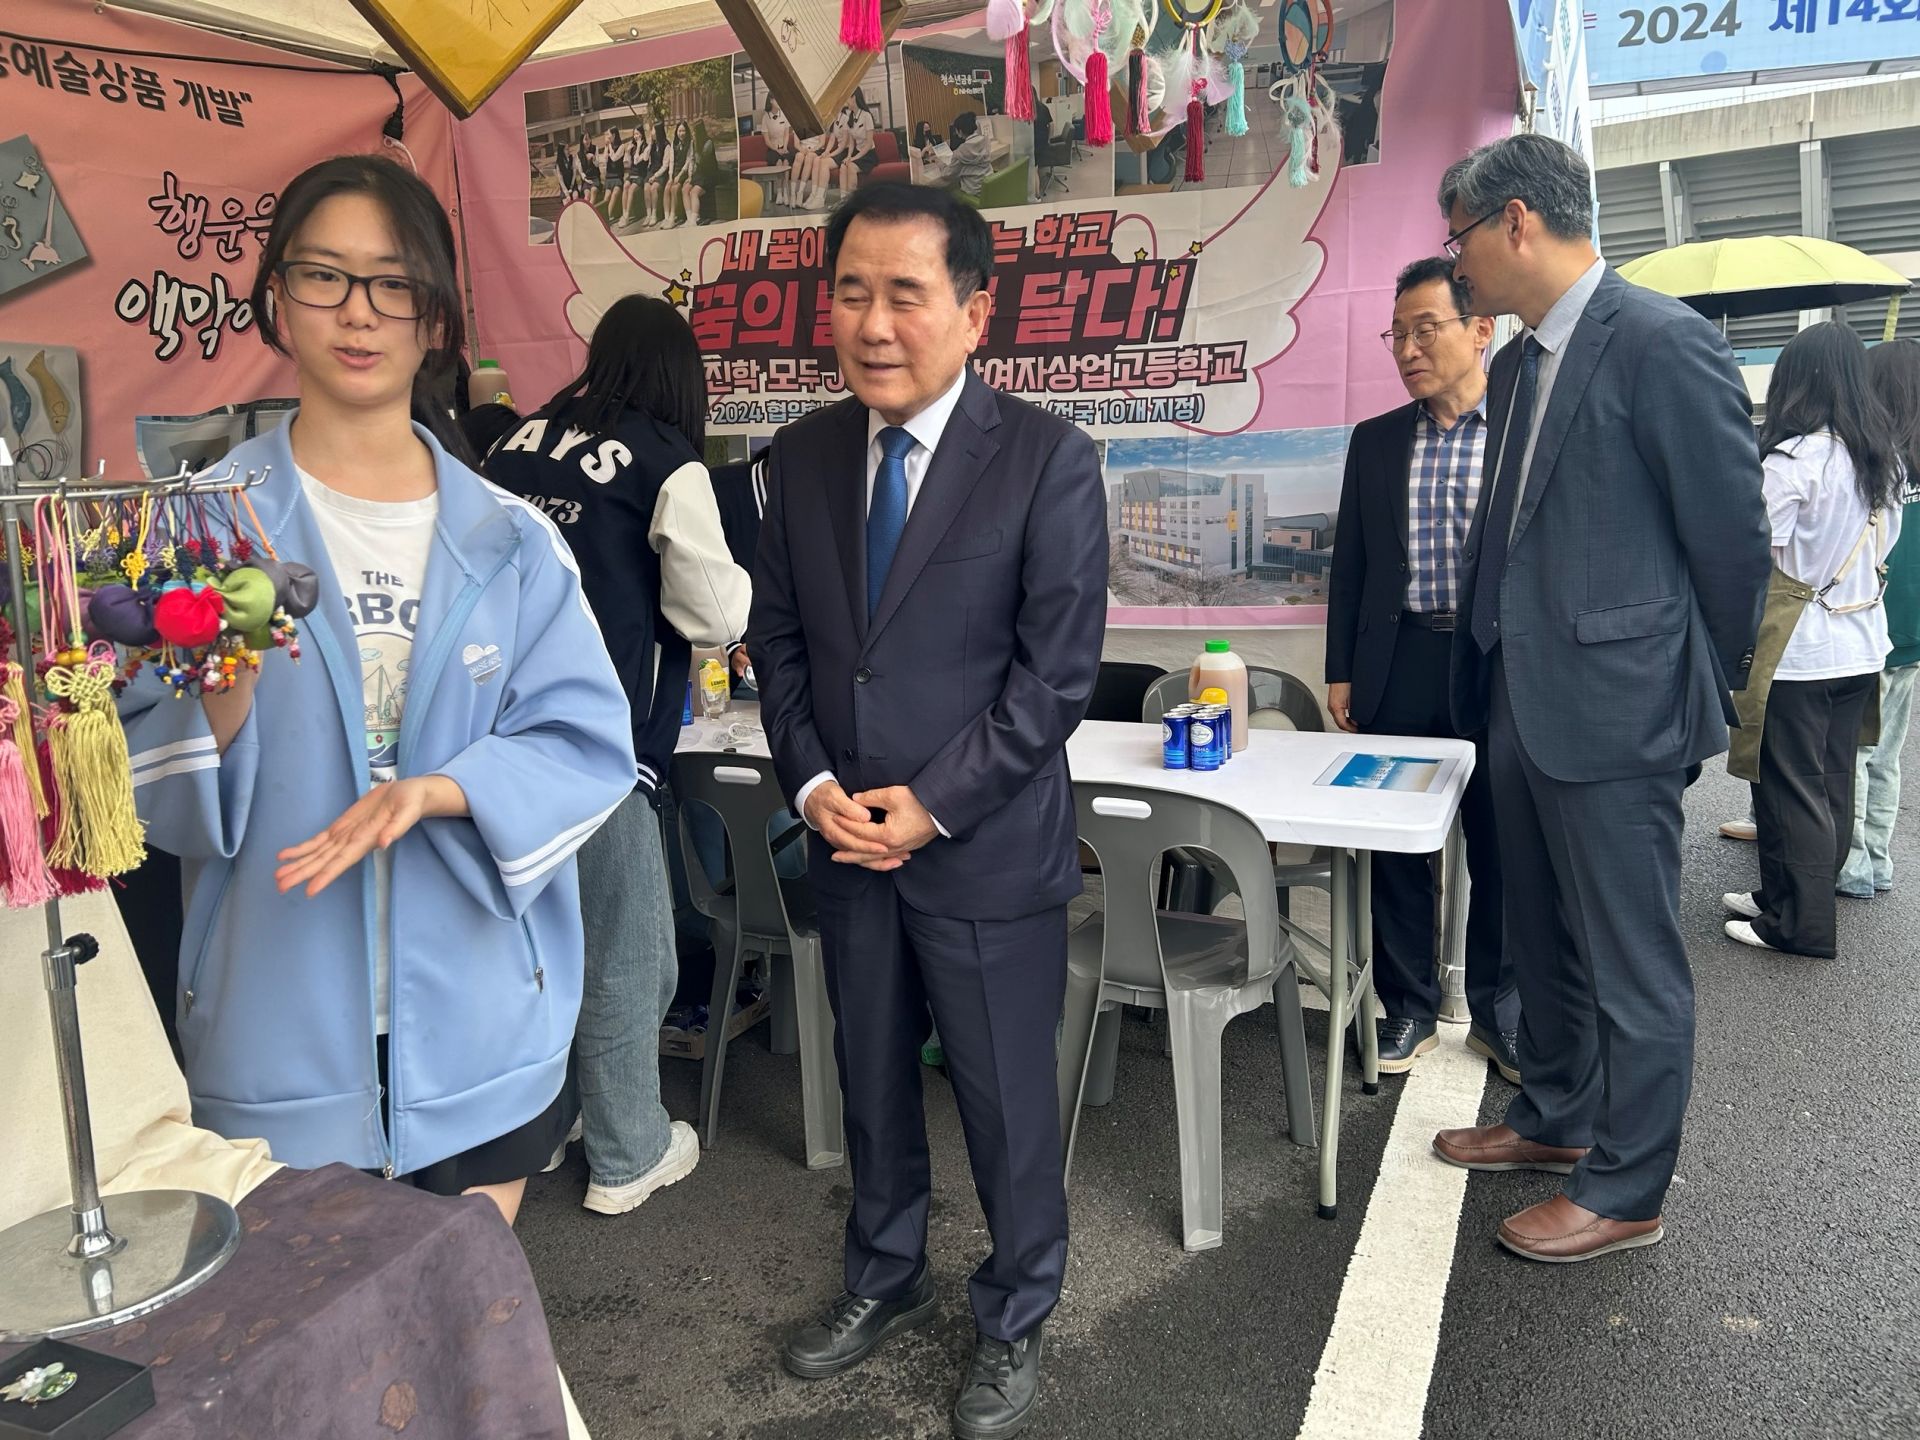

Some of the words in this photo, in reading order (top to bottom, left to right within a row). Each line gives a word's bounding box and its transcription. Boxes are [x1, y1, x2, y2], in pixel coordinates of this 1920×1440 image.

[1618, 0, 1742, 47] 2024
[722, 231, 761, 272] 내
[768, 227, 828, 270] 꿈이
[1033, 211, 1115, 259] 학교
[693, 280, 799, 350] 꿈의
[1014, 263, 1189, 345] 달다!
[974, 343, 1245, 391] 여자상업고등학교
[713, 401, 764, 424] 2024
[1099, 400, 1148, 424] 10개
[1150, 394, 1205, 423] 지정)
[480, 419, 633, 484] AYS
[361, 570, 405, 588] THE
